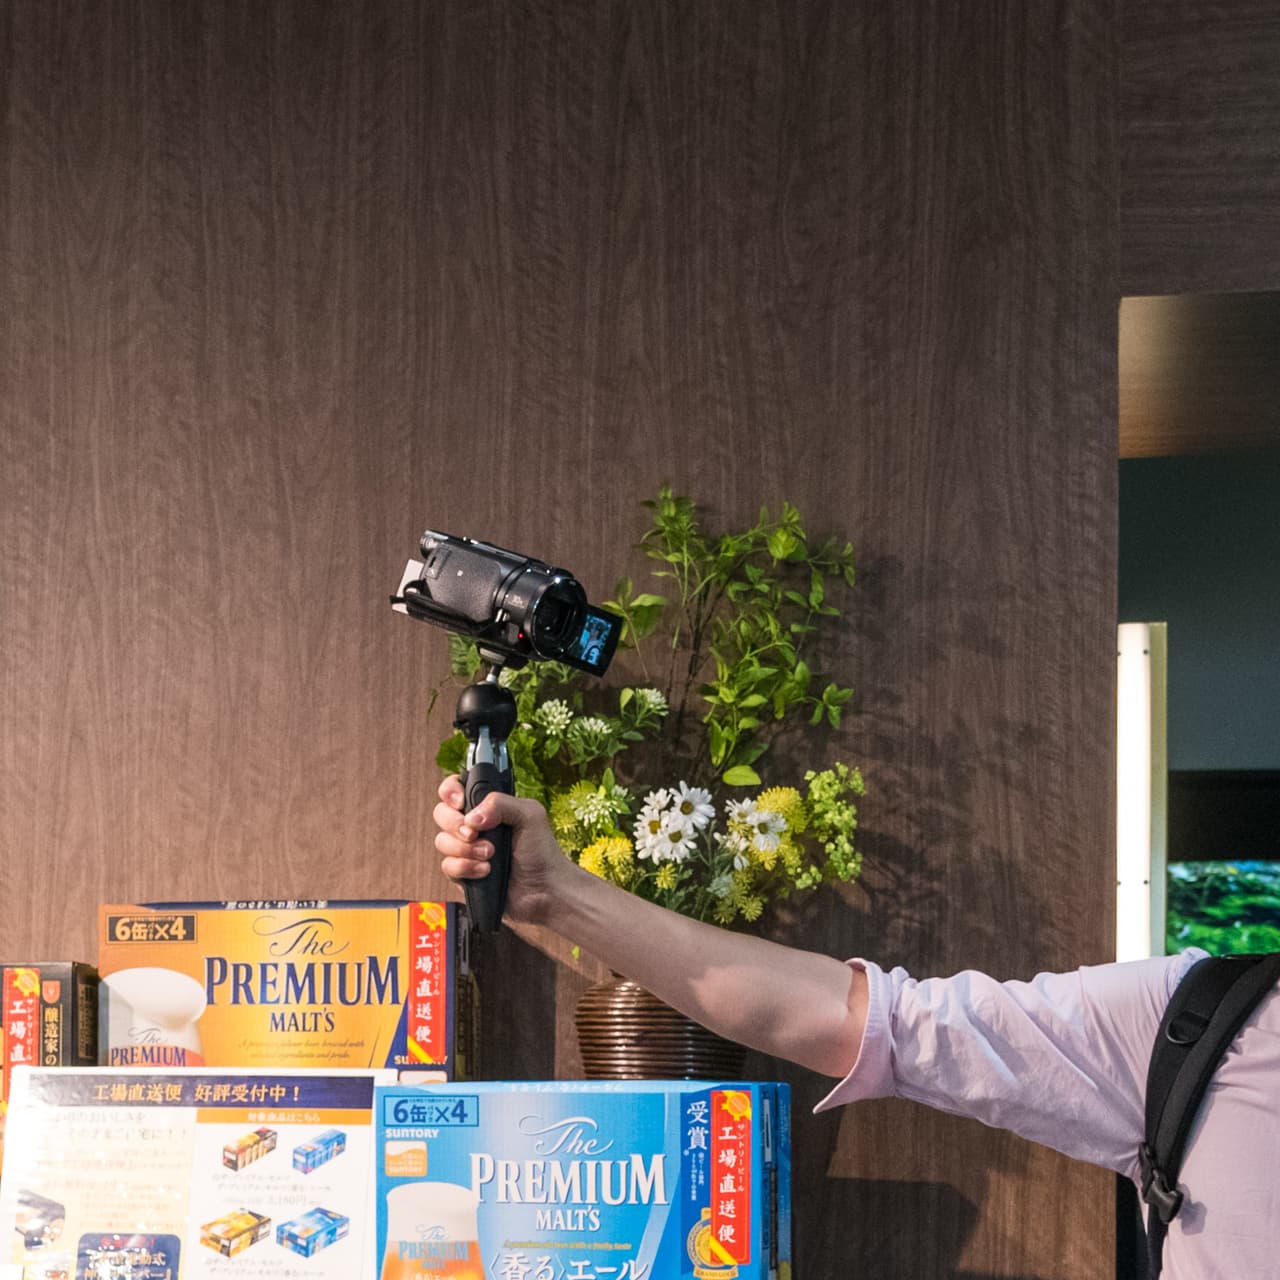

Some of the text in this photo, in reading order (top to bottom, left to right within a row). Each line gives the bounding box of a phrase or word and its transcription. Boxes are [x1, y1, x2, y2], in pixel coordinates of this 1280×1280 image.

[253, 915, 351, 957] The
[205, 956, 401, 1006] PREMIUM
[415, 934, 433, 1043] 工場直送便
[128, 1027, 169, 1044] The
[269, 1008, 336, 1033] MALT'S
[111, 1047, 186, 1067] PREMIUM
[94, 1083, 300, 1103] 工場直送便 好評受付中！
[385, 1128, 441, 1139] SUNTORY
[519, 1115, 614, 1156] The
[686, 1100, 710, 1151] 受賞
[737, 1123, 745, 1193] サントリービール
[470, 1153, 669, 1206] PREMIUM
[717, 1126, 738, 1244] 工場直送便
[536, 1205, 601, 1233] MALT'S
[399, 1240, 470, 1262] PREMIUM
